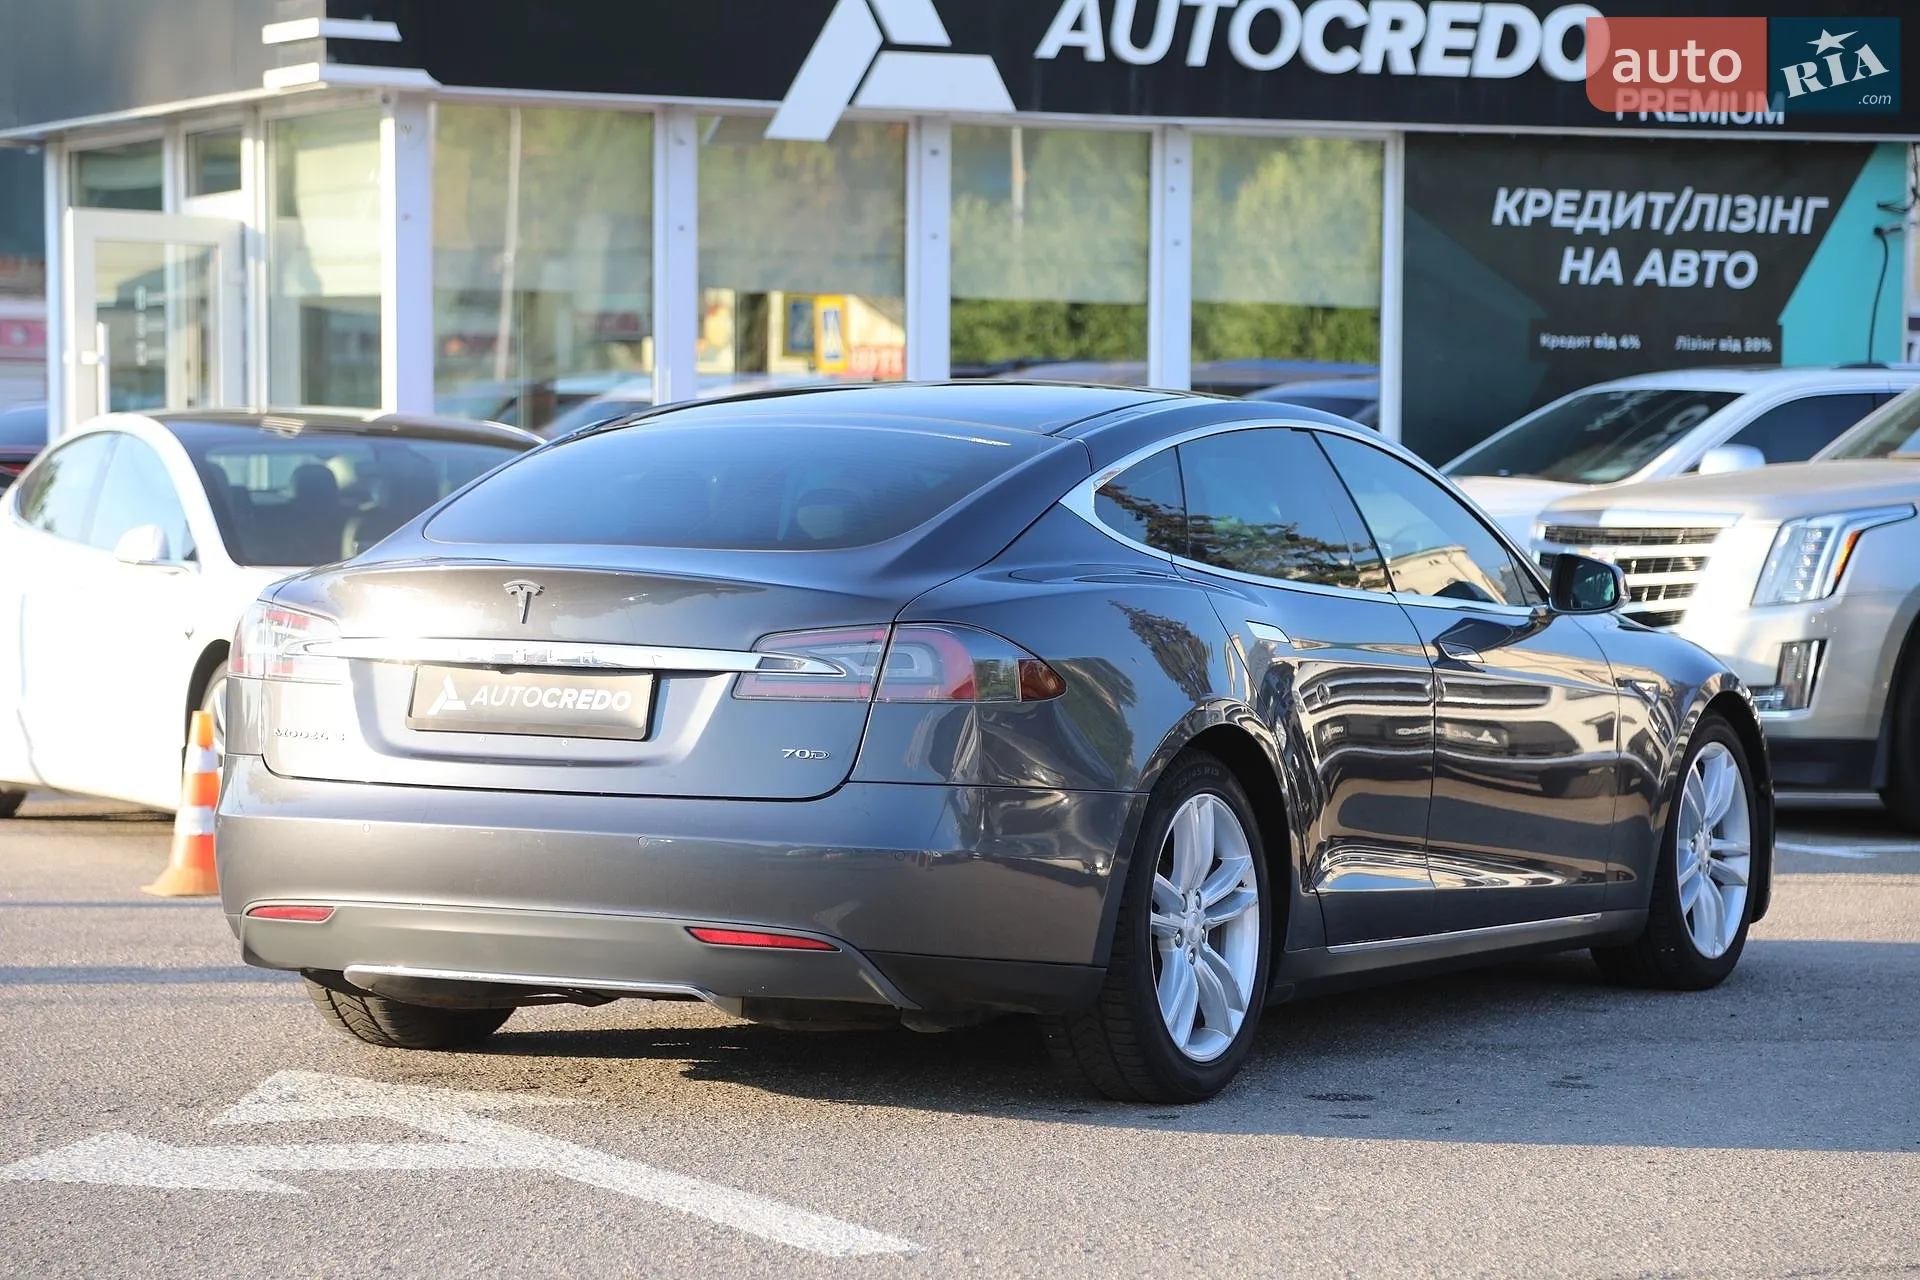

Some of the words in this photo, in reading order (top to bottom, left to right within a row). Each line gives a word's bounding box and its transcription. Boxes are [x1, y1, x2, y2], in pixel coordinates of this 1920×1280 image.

[1034, 0, 1610, 82] AUTOCREDO
[1615, 88, 1785, 125] PREMIUM
[1492, 186, 1829, 236] КРЕДИТ/ЛІЗІНГ
[1559, 246, 1624, 287] НА
[1633, 248, 1759, 290] АВТО
[1540, 333, 1592, 350] Кредит
[1593, 332, 1617, 351] від
[1675, 335, 1717, 351] Лізінг
[1718, 335, 1742, 353] від
[471, 685, 632, 712] AUTOCREDO
[781, 748, 830, 760] 70D
